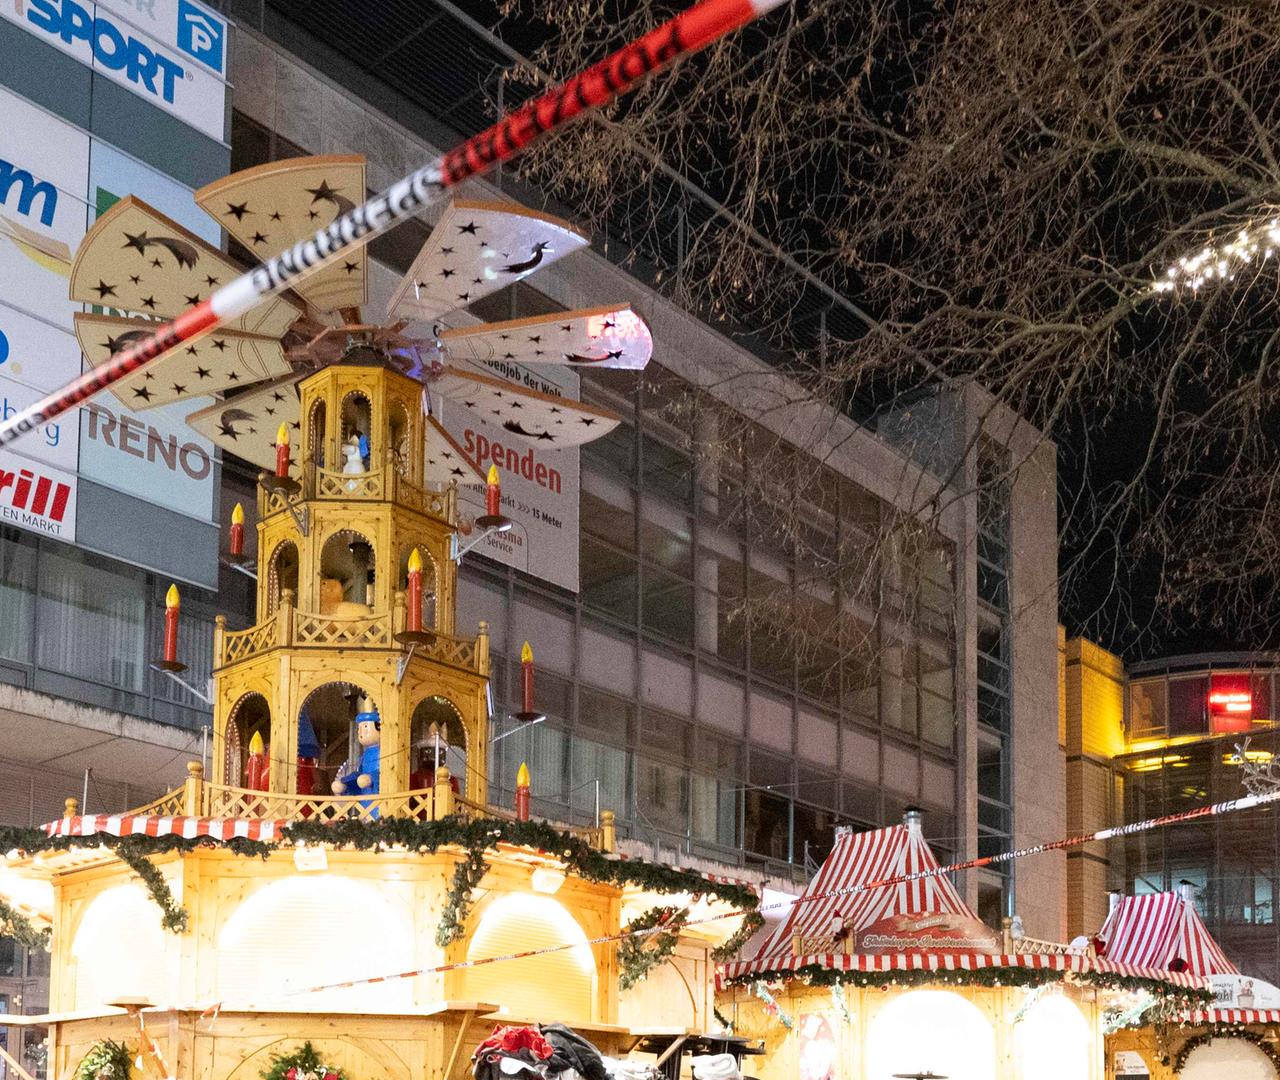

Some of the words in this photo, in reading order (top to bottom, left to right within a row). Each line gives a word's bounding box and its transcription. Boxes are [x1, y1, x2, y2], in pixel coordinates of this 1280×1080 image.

[523, 372, 539, 390] der
[87, 402, 211, 480] RENO
[464, 428, 561, 494] spenden
[21, 510, 63, 535] MARKT
[532, 508, 540, 519] 15
[542, 513, 563, 529] Meter
[487, 536, 513, 554] Service
